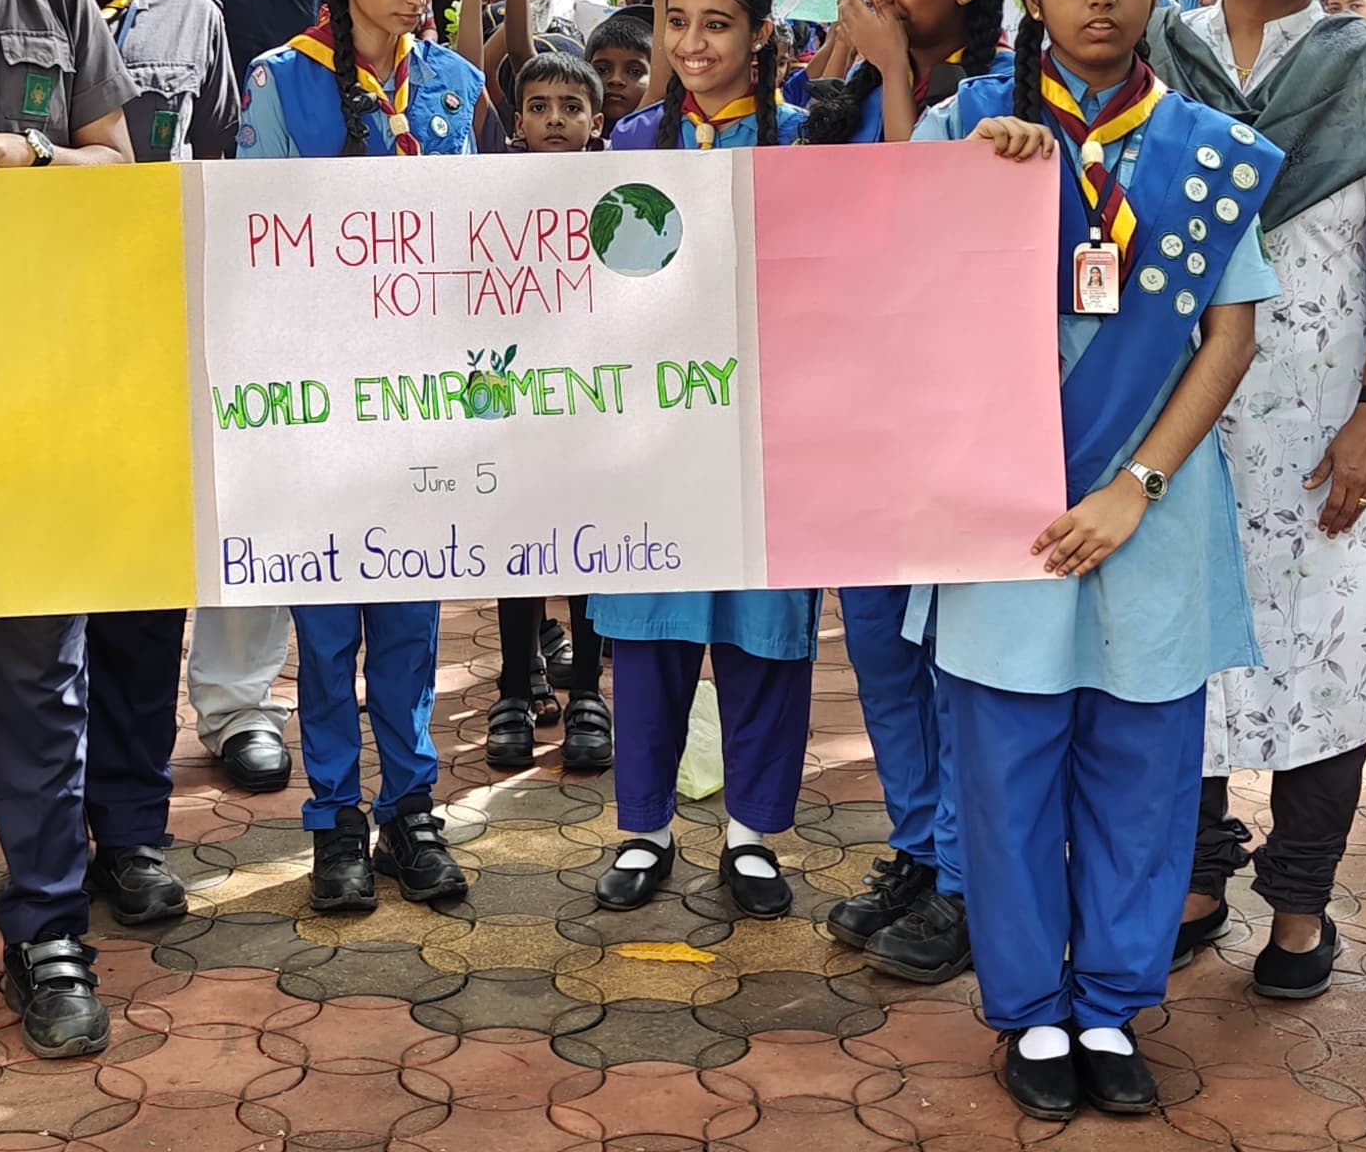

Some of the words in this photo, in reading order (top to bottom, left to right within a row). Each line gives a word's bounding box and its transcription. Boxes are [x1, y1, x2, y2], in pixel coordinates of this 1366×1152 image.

[248, 212, 315, 267] PM
[335, 210, 435, 266] SHRI
[469, 208, 591, 263] KVRB
[372, 264, 593, 319] KOTTAYAM
[212, 380, 331, 430] WORLD
[354, 364, 633, 421] ENVIRONMENT
[656, 357, 738, 409] DAY
[408, 466, 456, 493] June
[475, 462, 497, 494] 5
[223, 533, 343, 585] Bharat
[360, 523, 486, 579] Scouts
[506, 527, 558, 576] and
[573, 521, 681, 573] Guides
